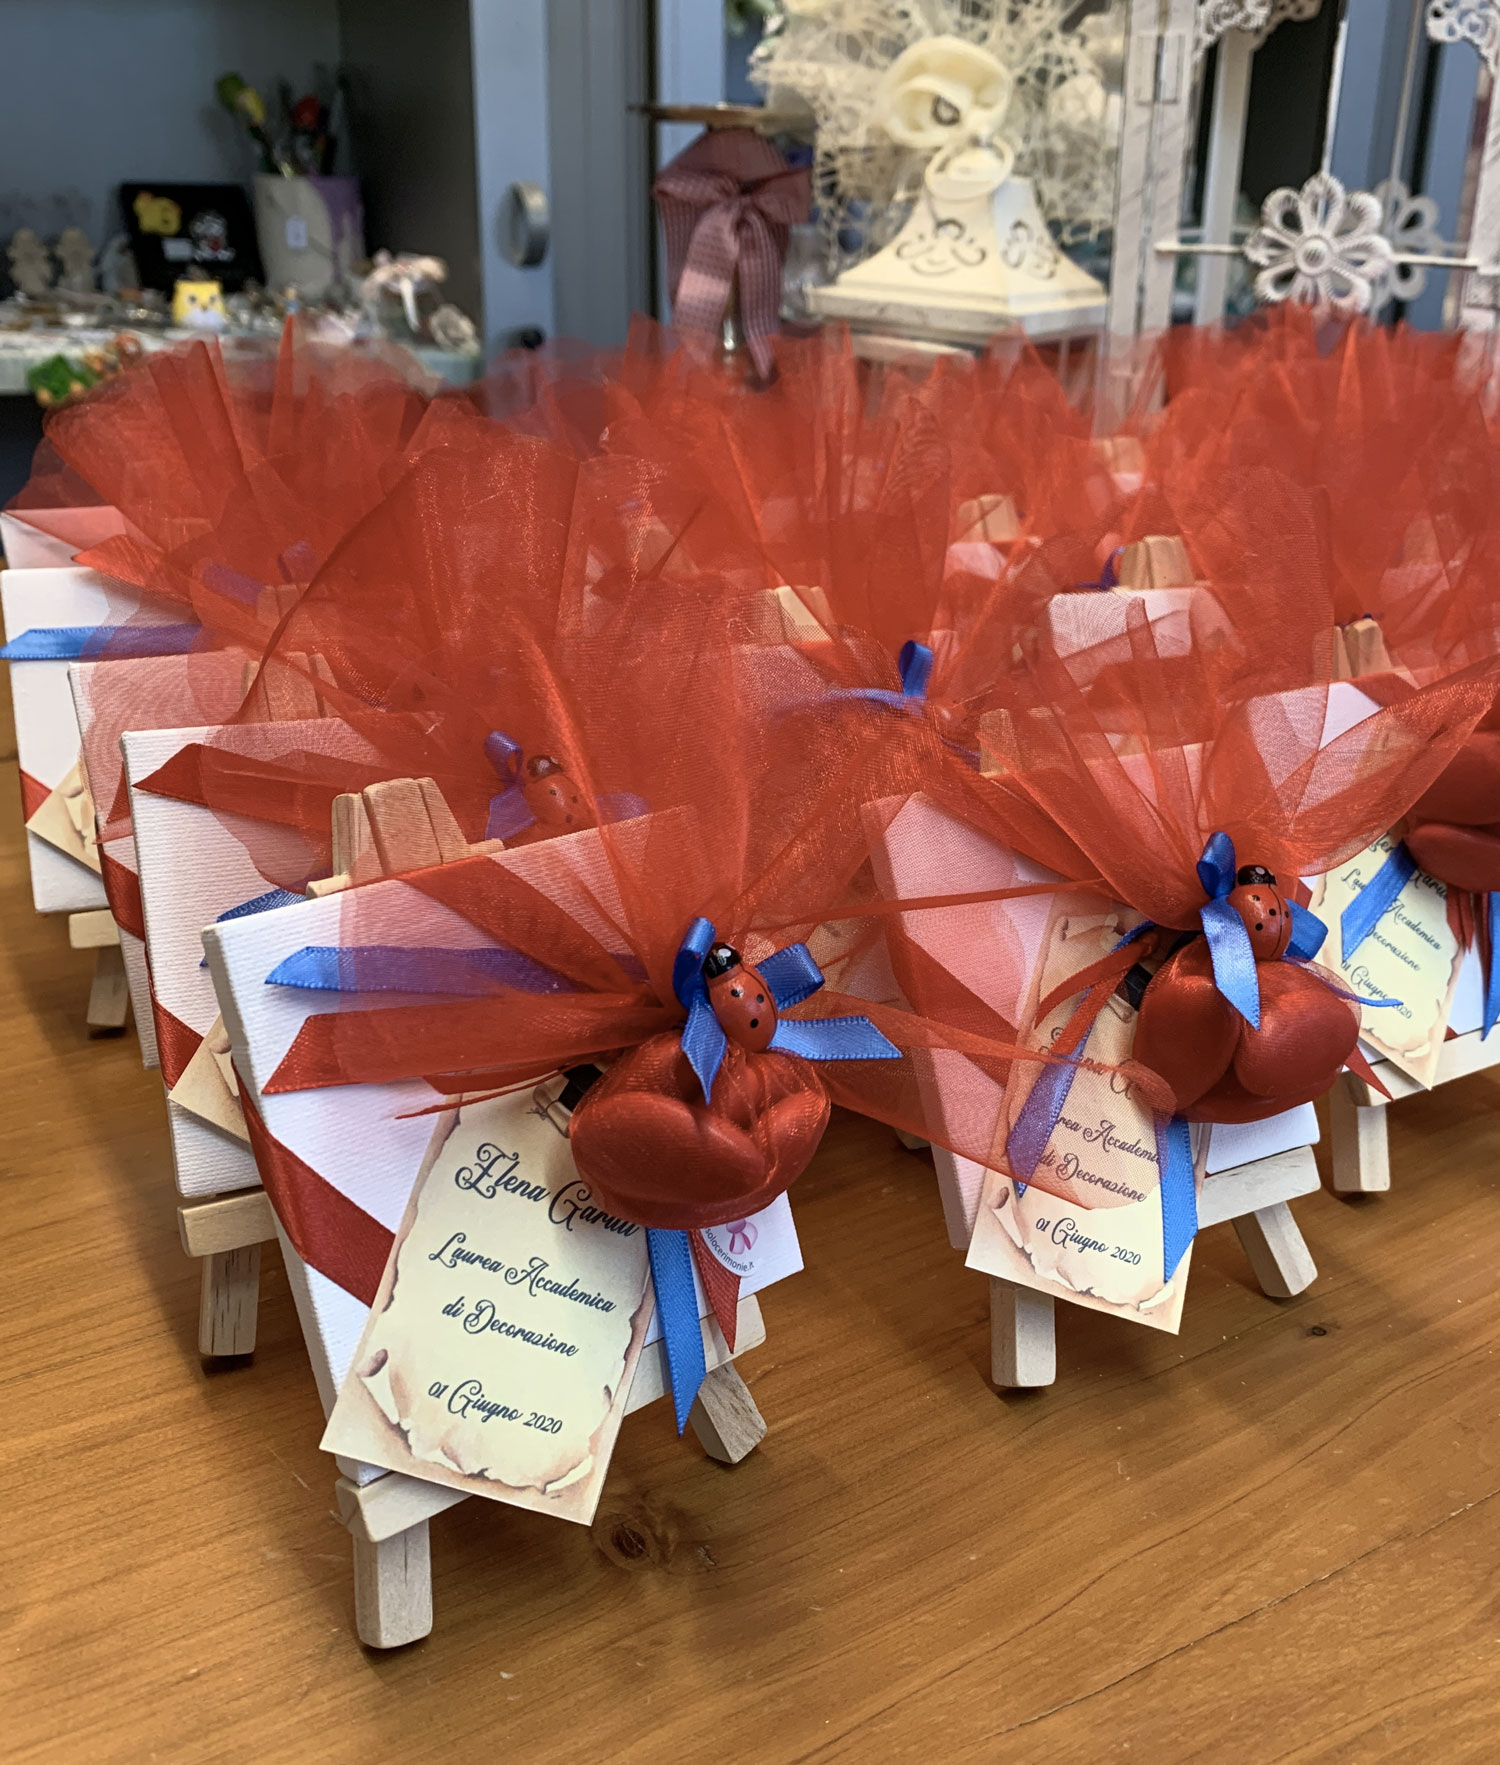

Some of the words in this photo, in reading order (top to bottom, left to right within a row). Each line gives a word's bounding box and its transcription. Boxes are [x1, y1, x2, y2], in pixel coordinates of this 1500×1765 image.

[1341, 868, 1366, 891] Lau
[1391, 1003, 1413, 1020] 020
[1057, 1116, 1083, 1132] rea
[1083, 1119, 1161, 1163] Accademi
[454, 1142, 550, 1202] Elena
[1056, 1152, 1148, 1203] Decorazione
[705, 1228, 755, 1272] solocerimonie.it
[1036, 1217, 1051, 1232] 01
[1051, 1217, 1110, 1254] Giugno
[1110, 1246, 1142, 1266] 2020
[428, 1232, 506, 1273] Laurea
[504, 1256, 617, 1313] Accademica
[441, 1296, 466, 1318] di
[462, 1299, 579, 1357] Decorazione
[428, 1381, 449, 1399] 01
[447, 1379, 524, 1423] Giugno
[522, 1412, 563, 1434] 2020
